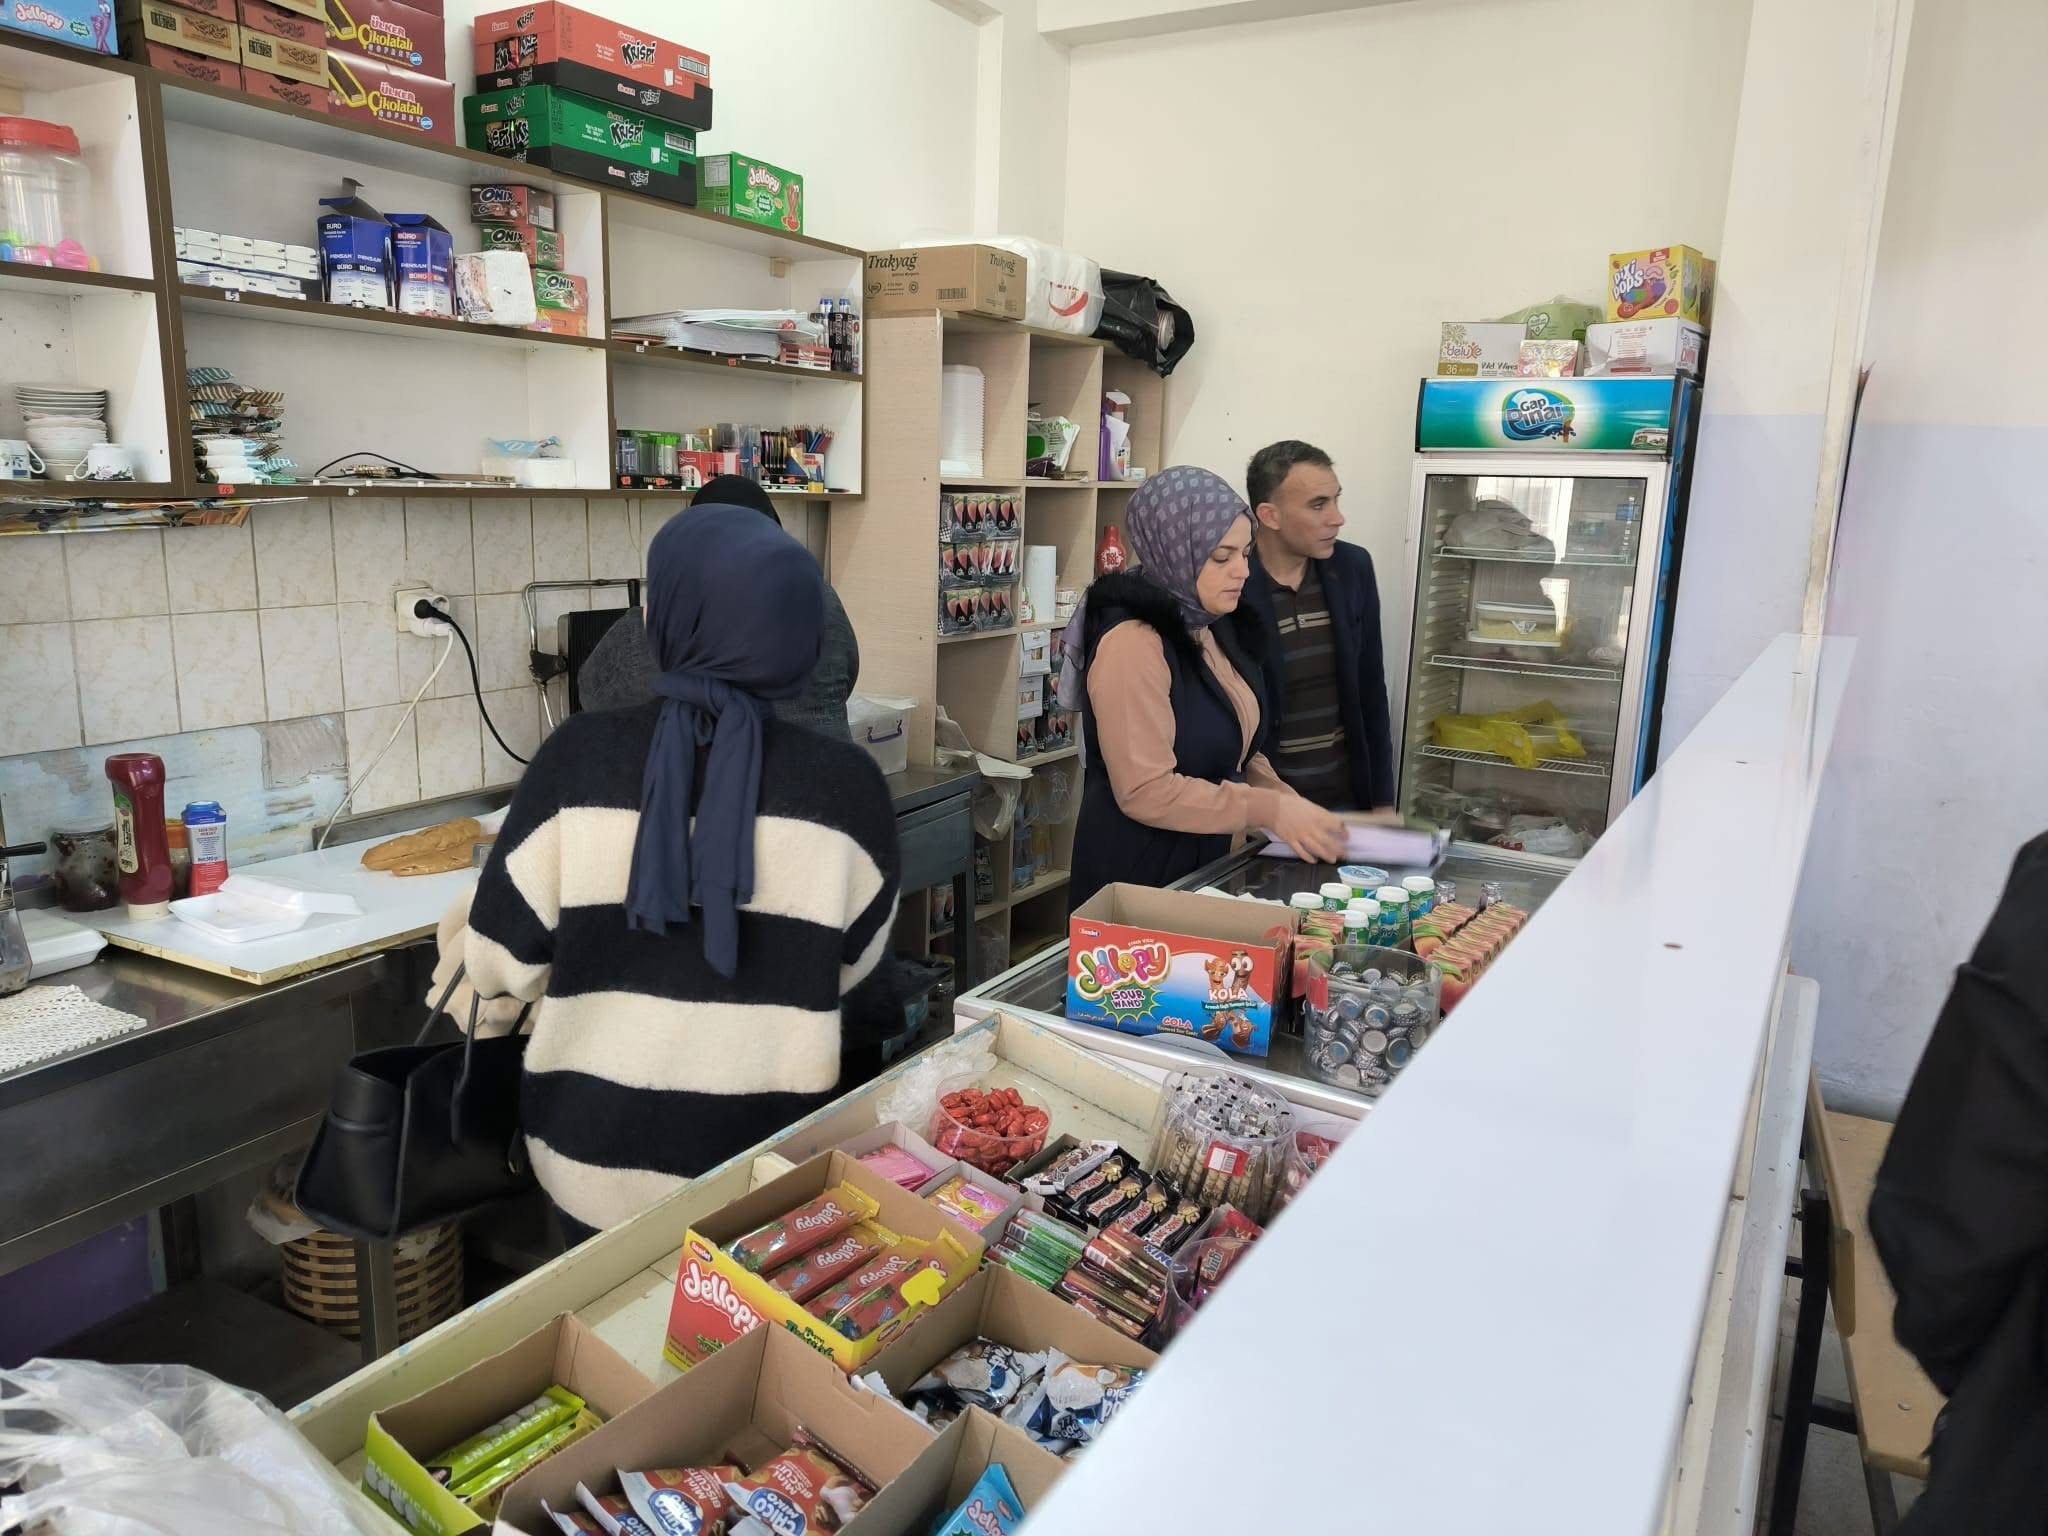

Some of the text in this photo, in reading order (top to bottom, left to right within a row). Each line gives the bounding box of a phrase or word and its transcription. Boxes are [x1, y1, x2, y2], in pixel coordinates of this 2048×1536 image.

[748, 165, 781, 196] Jellopy
[480, 187, 515, 203] ONIX
[492, 228, 524, 243] ONIX
[868, 252, 919, 271] Trakyağ
[546, 274, 576, 289] ONIX
[1446, 364, 1458, 375] 36
[1519, 398, 1547, 412] Gap
[1078, 943, 1169, 997] Jellopy
[1111, 989, 1145, 1001] SOUR
[1209, 987, 1248, 1001] KOLA
[1111, 999, 1142, 1009] WAND
[1162, 1016, 1193, 1029] COLA
[795, 1202, 844, 1232] Jellopy
[816, 1237, 866, 1268] Jellopy
[859, 1255, 908, 1287] Jellopy
[767, 1492, 798, 1518] MIKO
[753, 1496, 800, 1536] CHICO
[967, 1500, 1006, 1536] Jello
